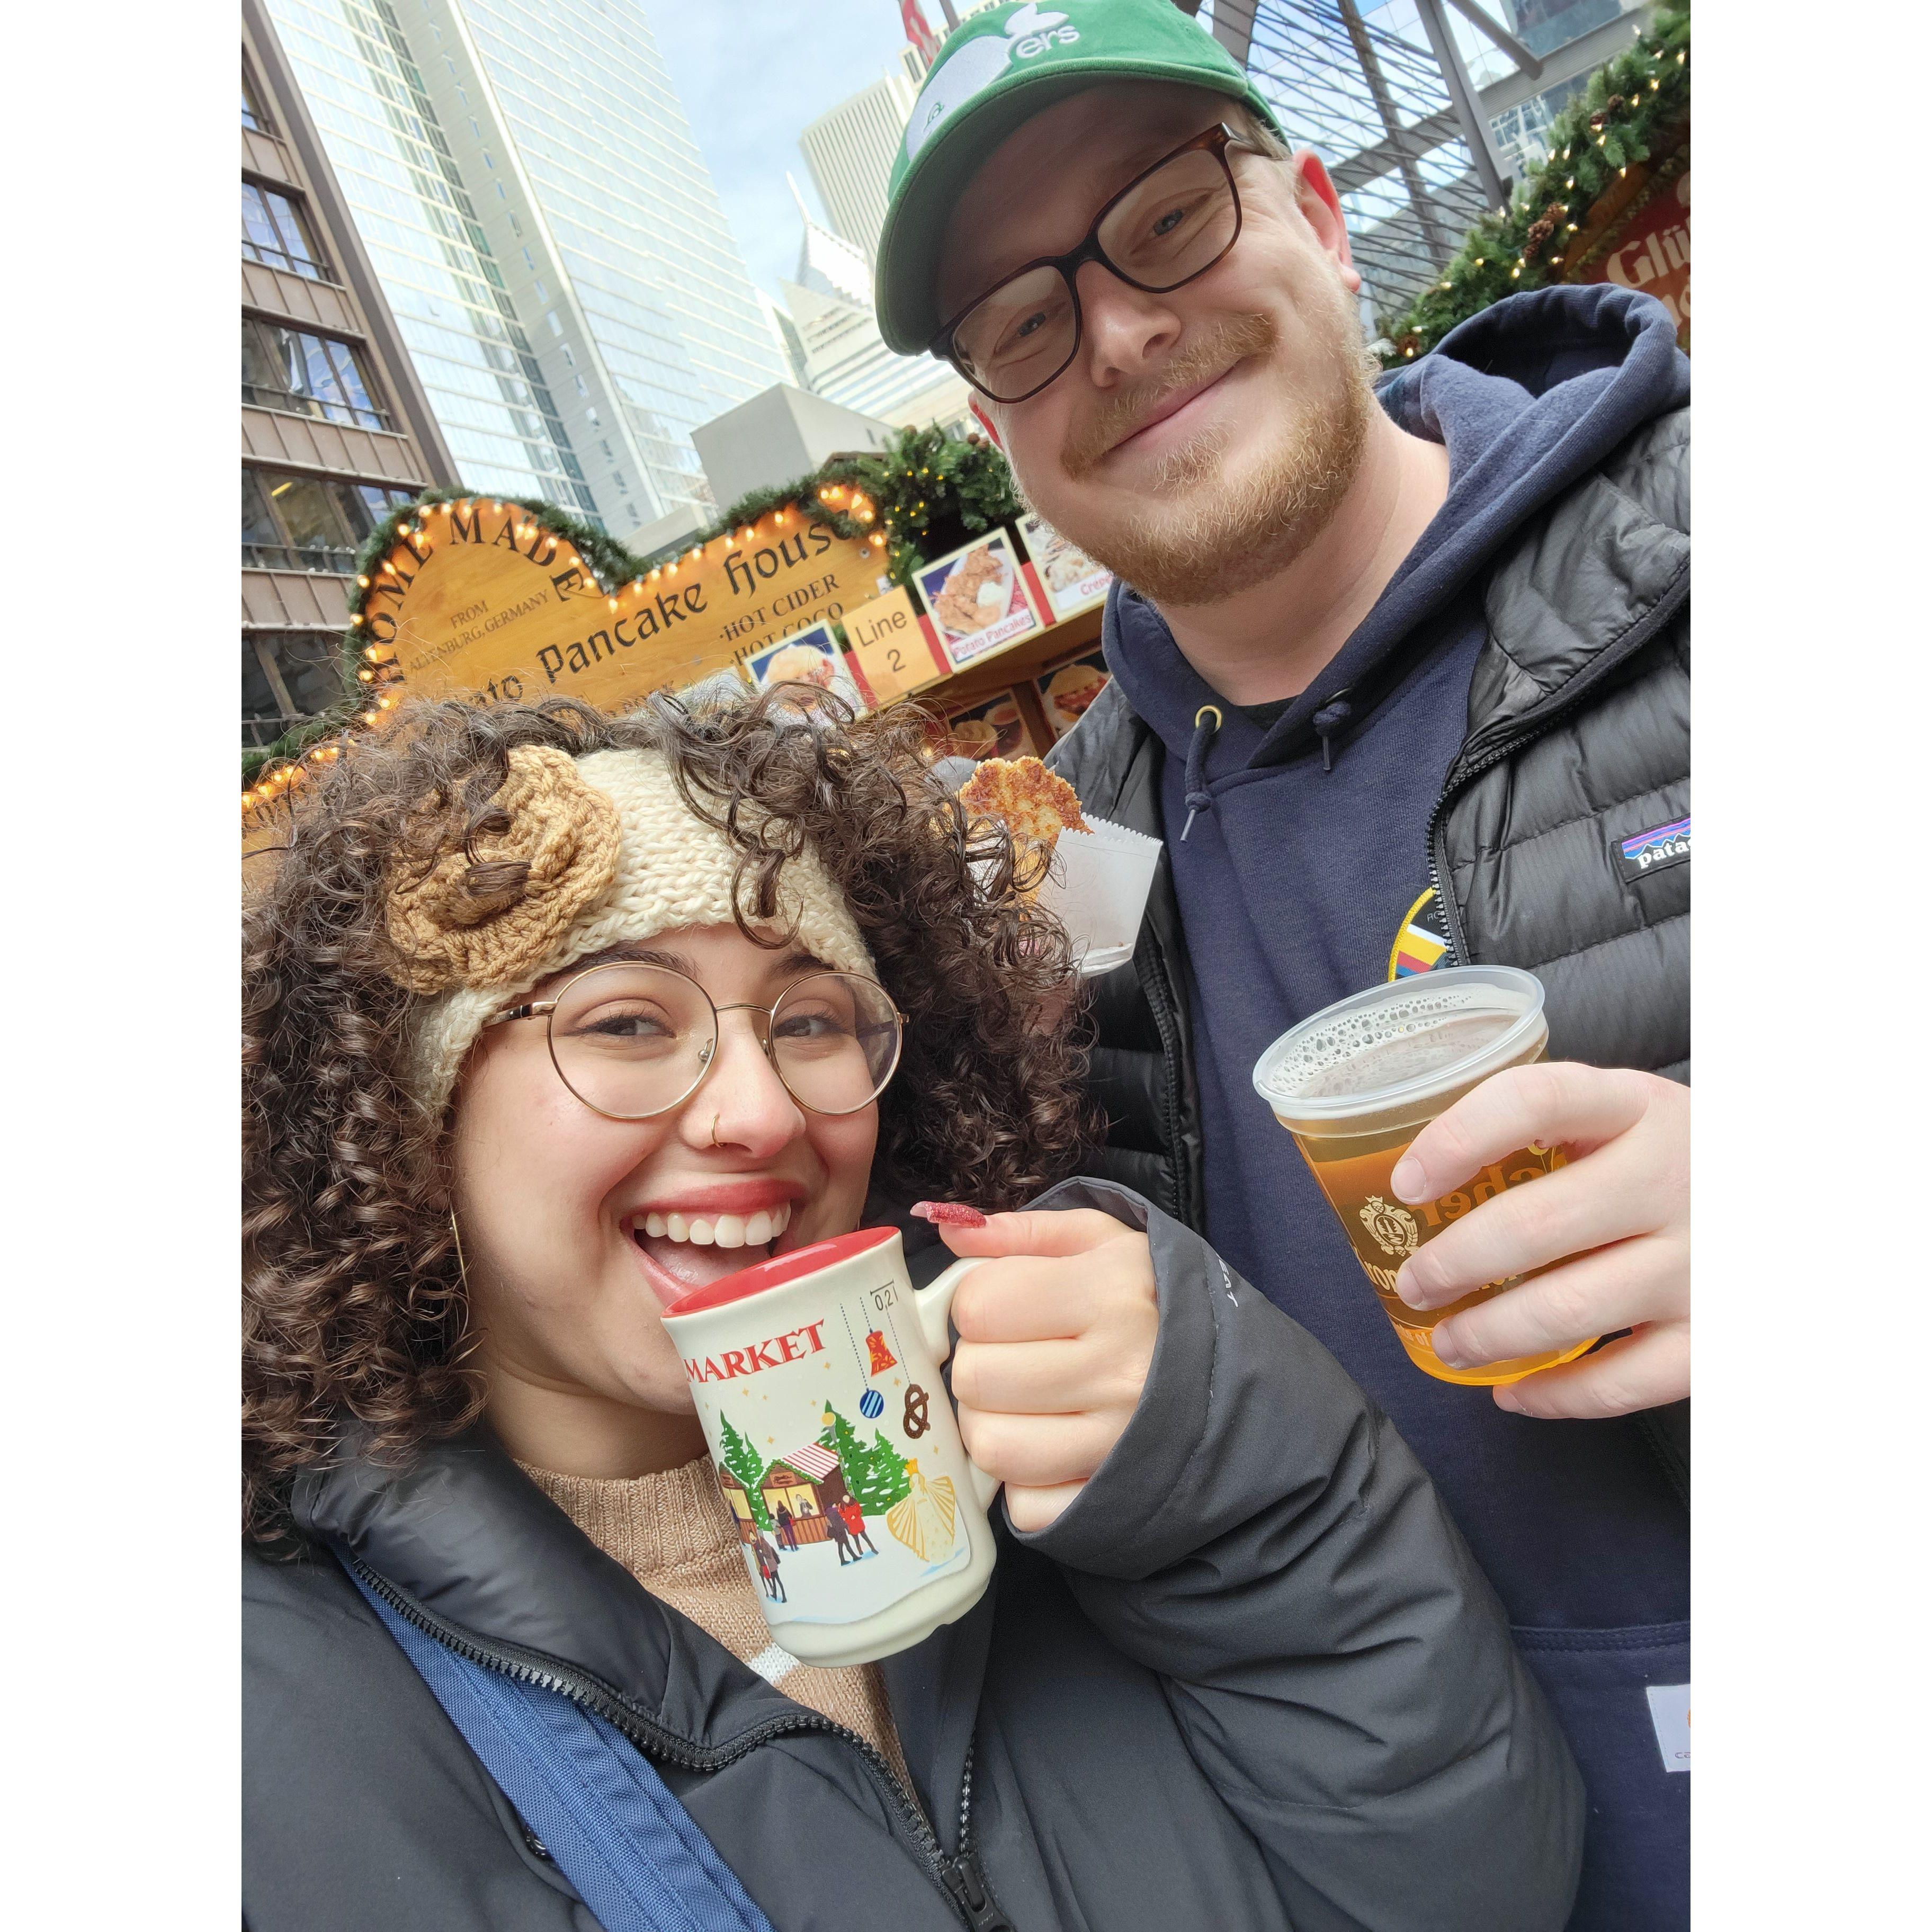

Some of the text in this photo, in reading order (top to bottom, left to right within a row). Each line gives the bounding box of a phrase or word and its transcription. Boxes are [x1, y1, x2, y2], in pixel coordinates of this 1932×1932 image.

[1016, 25, 1080, 58] ers
[1607, 215, 1690, 289] Glü
[449, 507, 585, 603] MADE
[450, 600, 489, 629] FROM
[484, 589, 549, 632] GERMANY
[723, 574, 840, 642] HOT CIDER
[855, 611, 907, 647] Line
[986, 614, 1031, 642] Pancakes
[887, 649, 907, 673] 2
[1637, 838, 1690, 870] pata
[683, 1318, 827, 1383] MARKET
